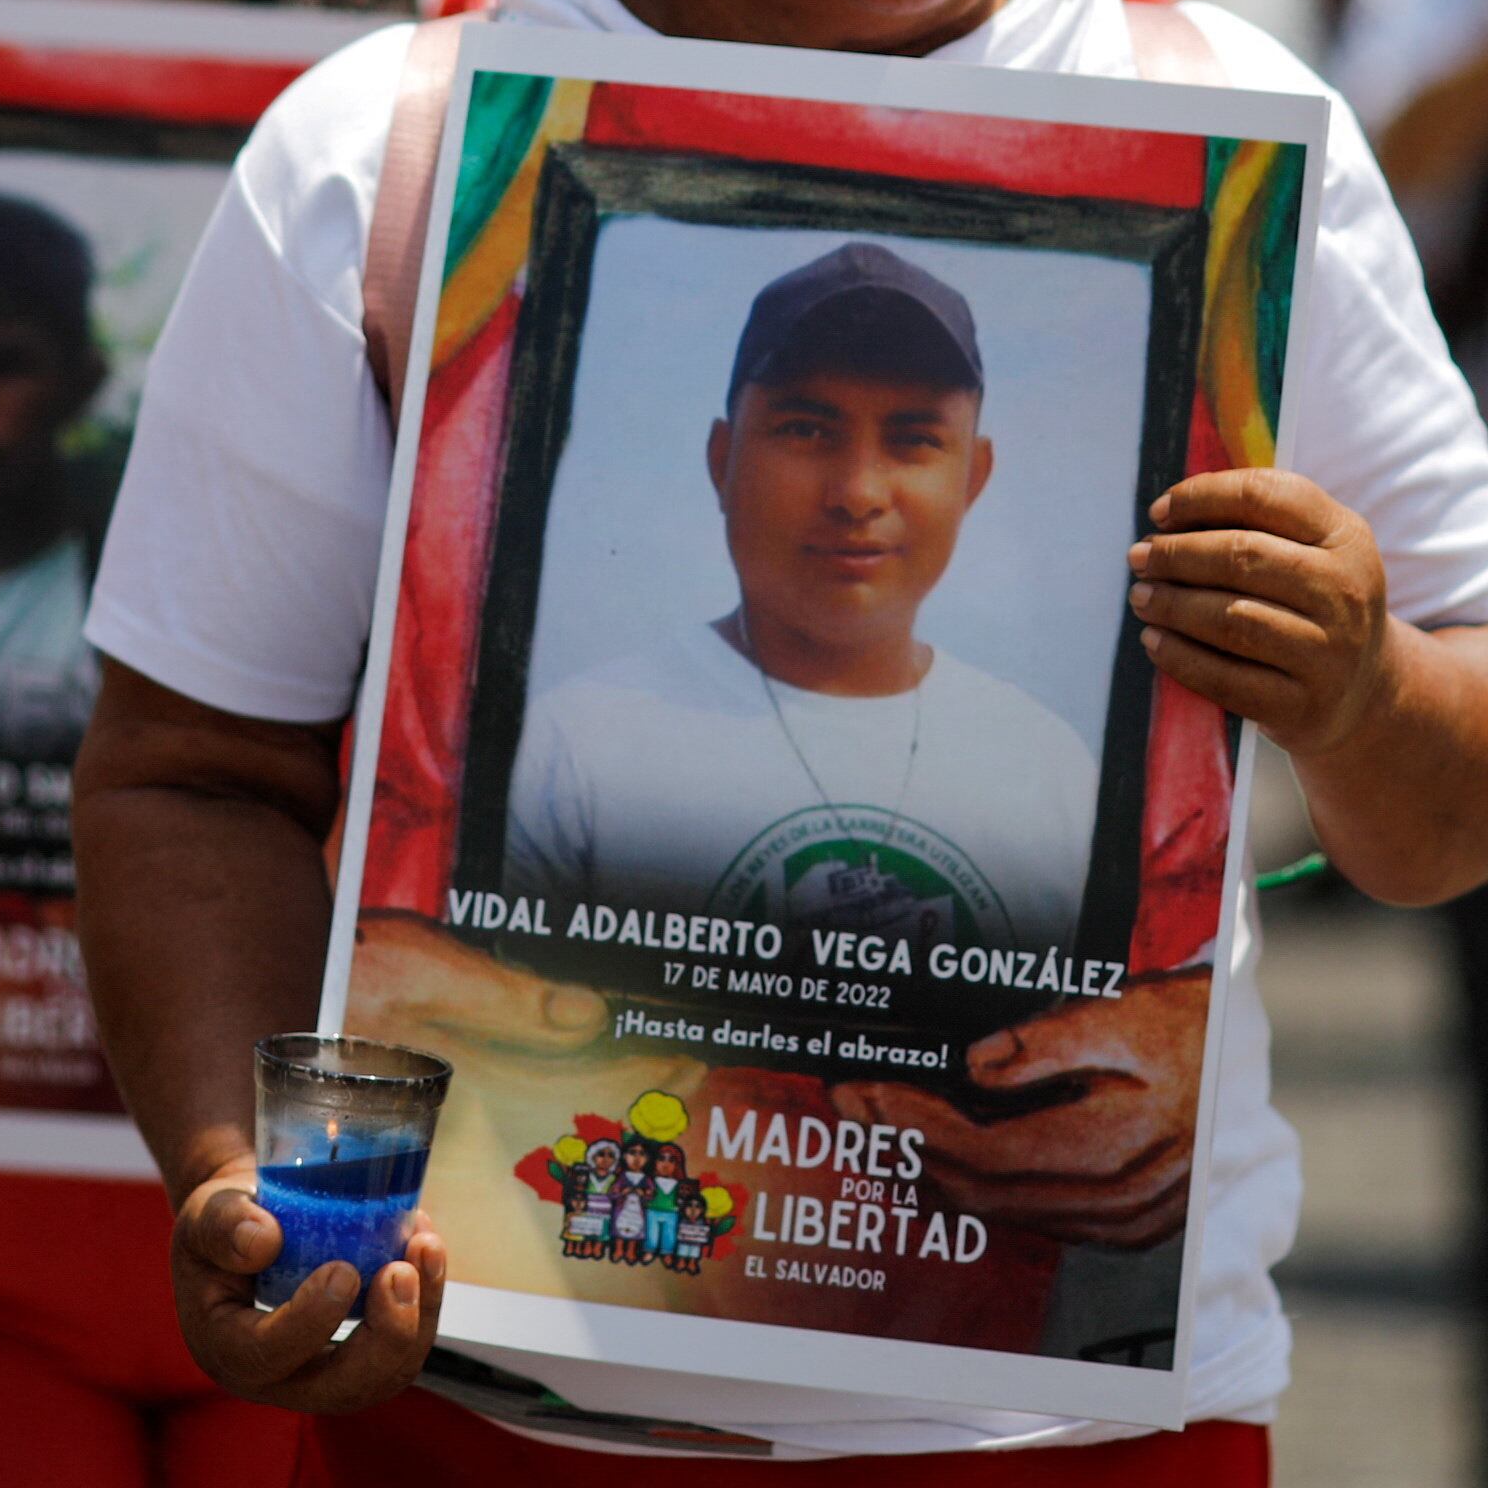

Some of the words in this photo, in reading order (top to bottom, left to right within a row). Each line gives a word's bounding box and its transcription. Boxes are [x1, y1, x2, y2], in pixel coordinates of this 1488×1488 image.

[448, 887, 552, 936] VIDAL
[565, 902, 783, 961] ADALBERTO
[812, 928, 912, 976] VEGA
[928, 943, 1125, 999] GONZÁLEZ
[663, 961, 684, 985] 17
[692, 966, 721, 991] DE
[727, 968, 793, 998] MAYO
[800, 976, 829, 1002] DE
[835, 981, 892, 1009] 2022
[613, 1009, 705, 1042] ¡Hasta
[711, 1020, 800, 1053] darles
[806, 1030, 832, 1056] el
[837, 1034, 949, 1069] abrazo!
[706, 1105, 926, 1181] MADRES
[840, 1177, 885, 1203] POR
[891, 1182, 919, 1207] LA
[753, 1191, 988, 1264] LIBERTAD
[744, 1254, 768, 1279] EL
[774, 1258, 887, 1291] SALVADOR
